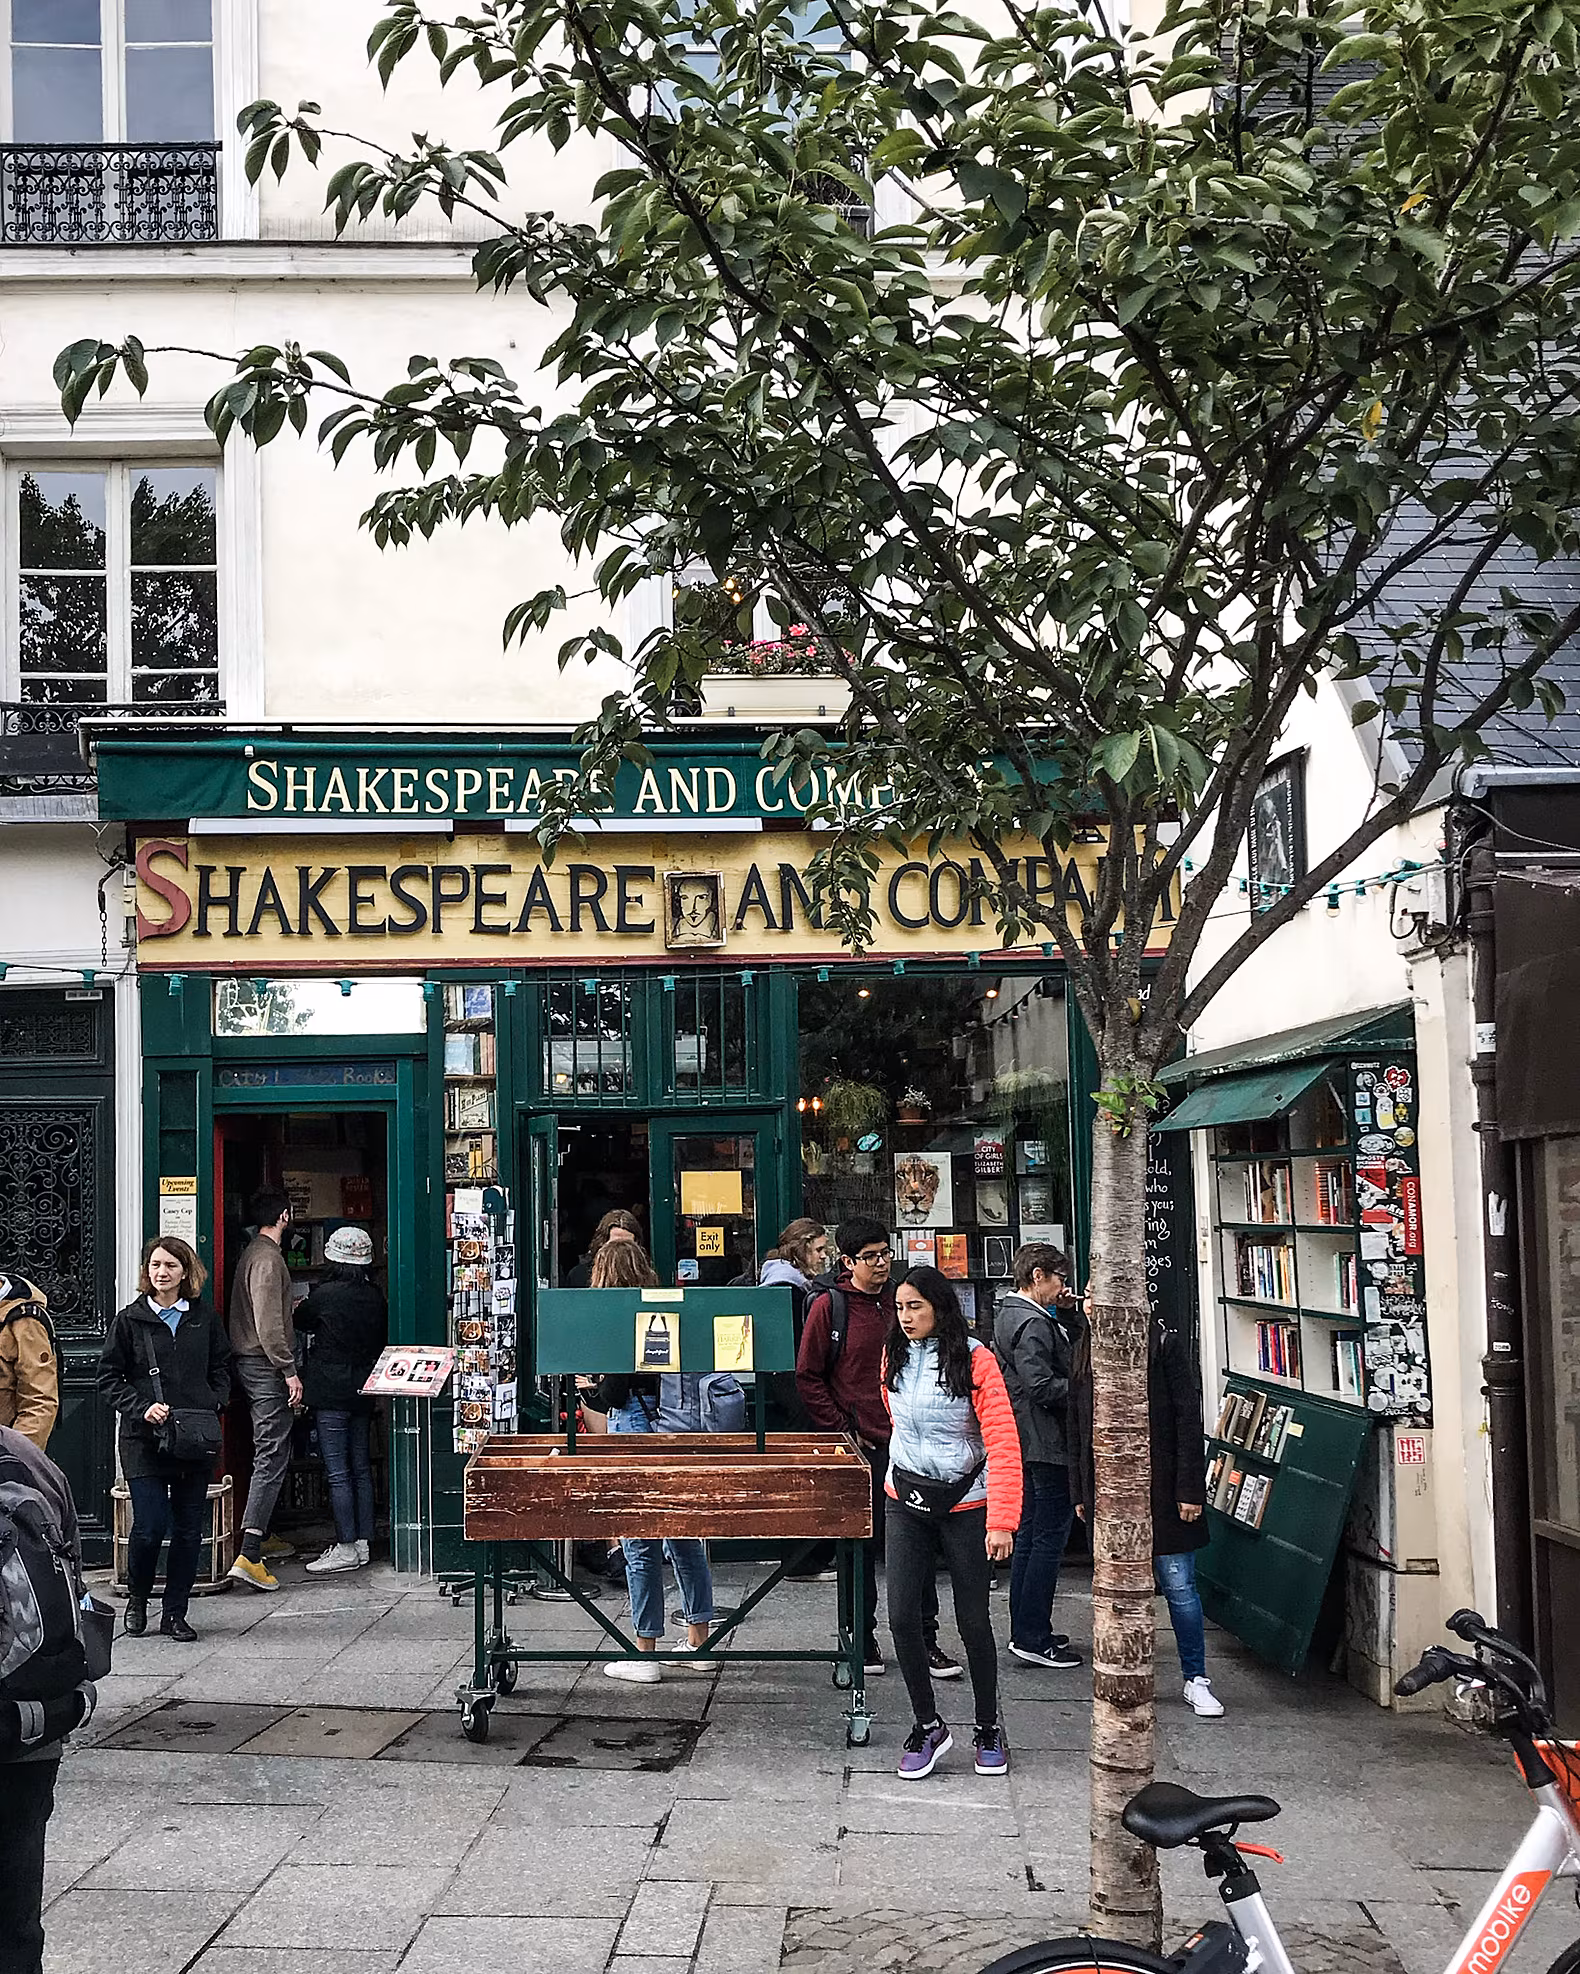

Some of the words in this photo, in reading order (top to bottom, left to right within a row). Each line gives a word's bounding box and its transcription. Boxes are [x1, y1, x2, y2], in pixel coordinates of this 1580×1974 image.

[632, 767, 737, 813] AND
[756, 766, 995, 813] COMP
[136, 839, 656, 943] SHAKESPEARE
[888, 857, 1177, 929] COMPA
[162, 1179, 195, 1188] Upcoming
[699, 1241, 720, 1252] only
[701, 1232, 719, 1241] Exit
[1467, 1884, 1531, 1974] mobike
